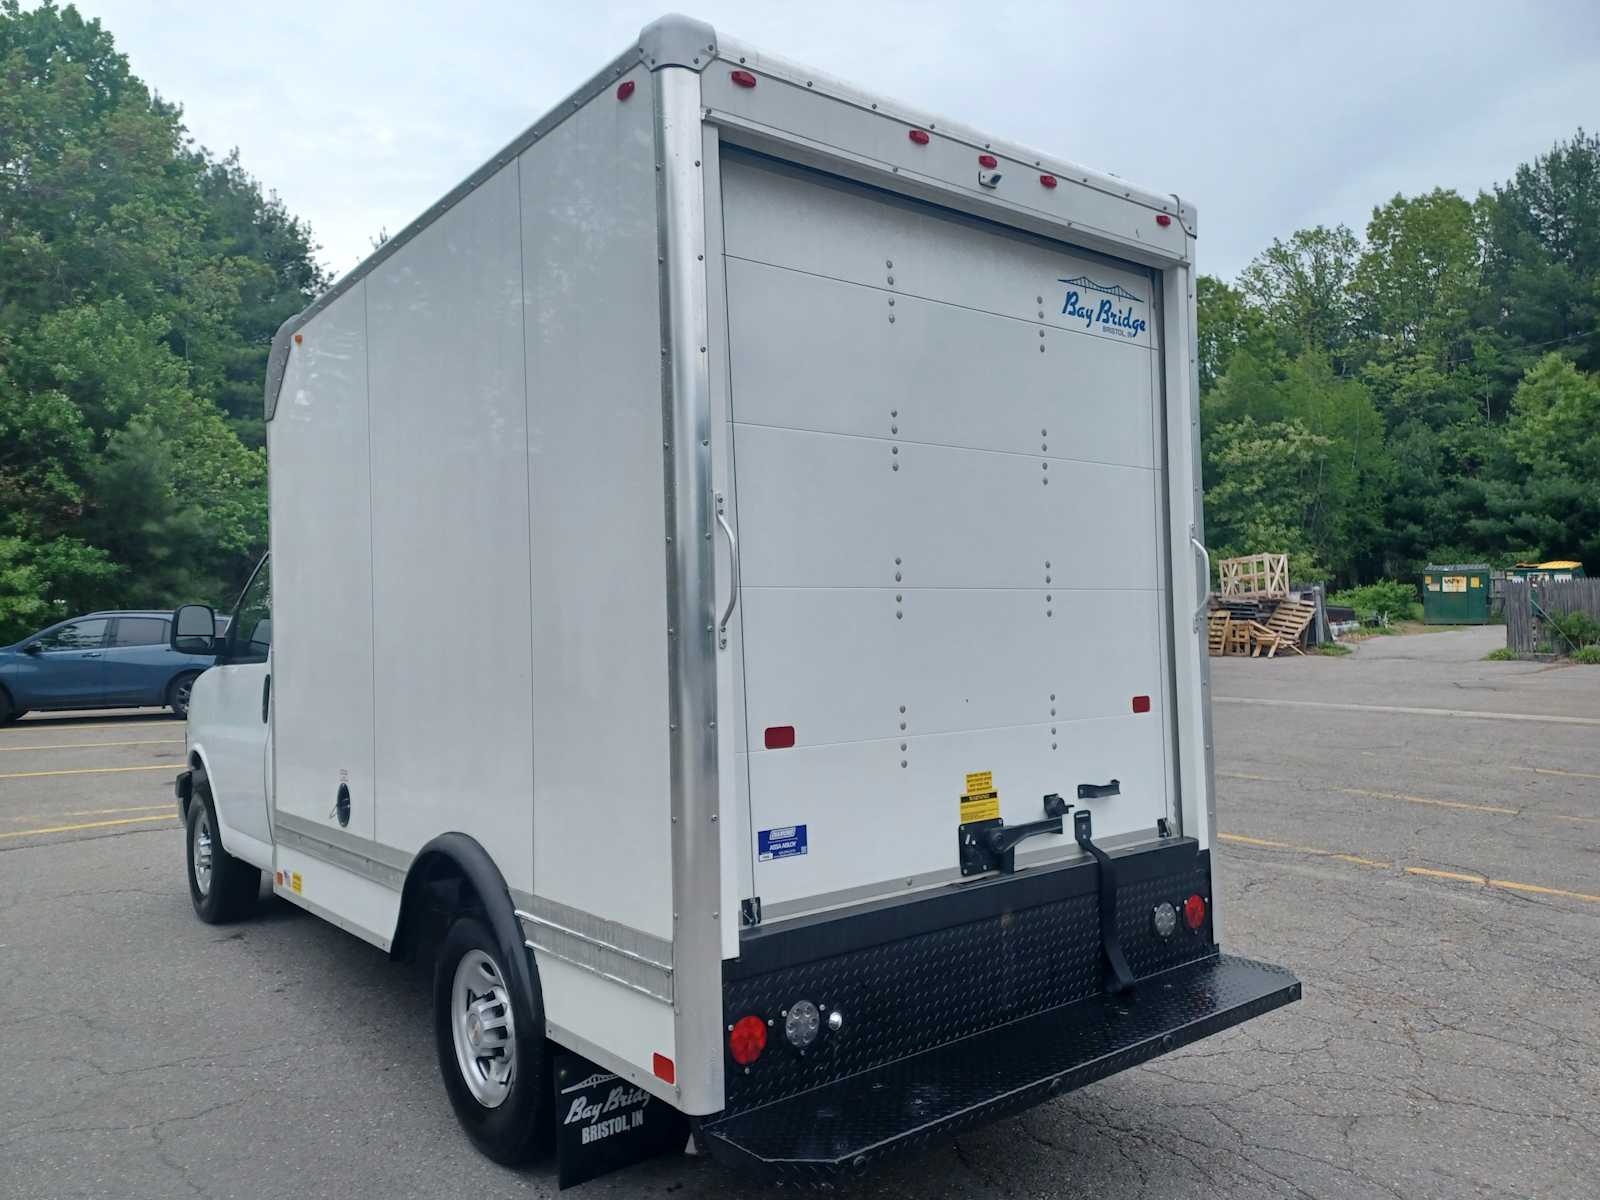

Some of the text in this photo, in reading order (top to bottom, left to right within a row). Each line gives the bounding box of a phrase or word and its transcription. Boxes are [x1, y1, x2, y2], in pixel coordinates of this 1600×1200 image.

[1062, 291, 1146, 337] Bay Bridge
[563, 1085, 651, 1125] Bay Bridg
[631, 1109, 644, 1128] IN
